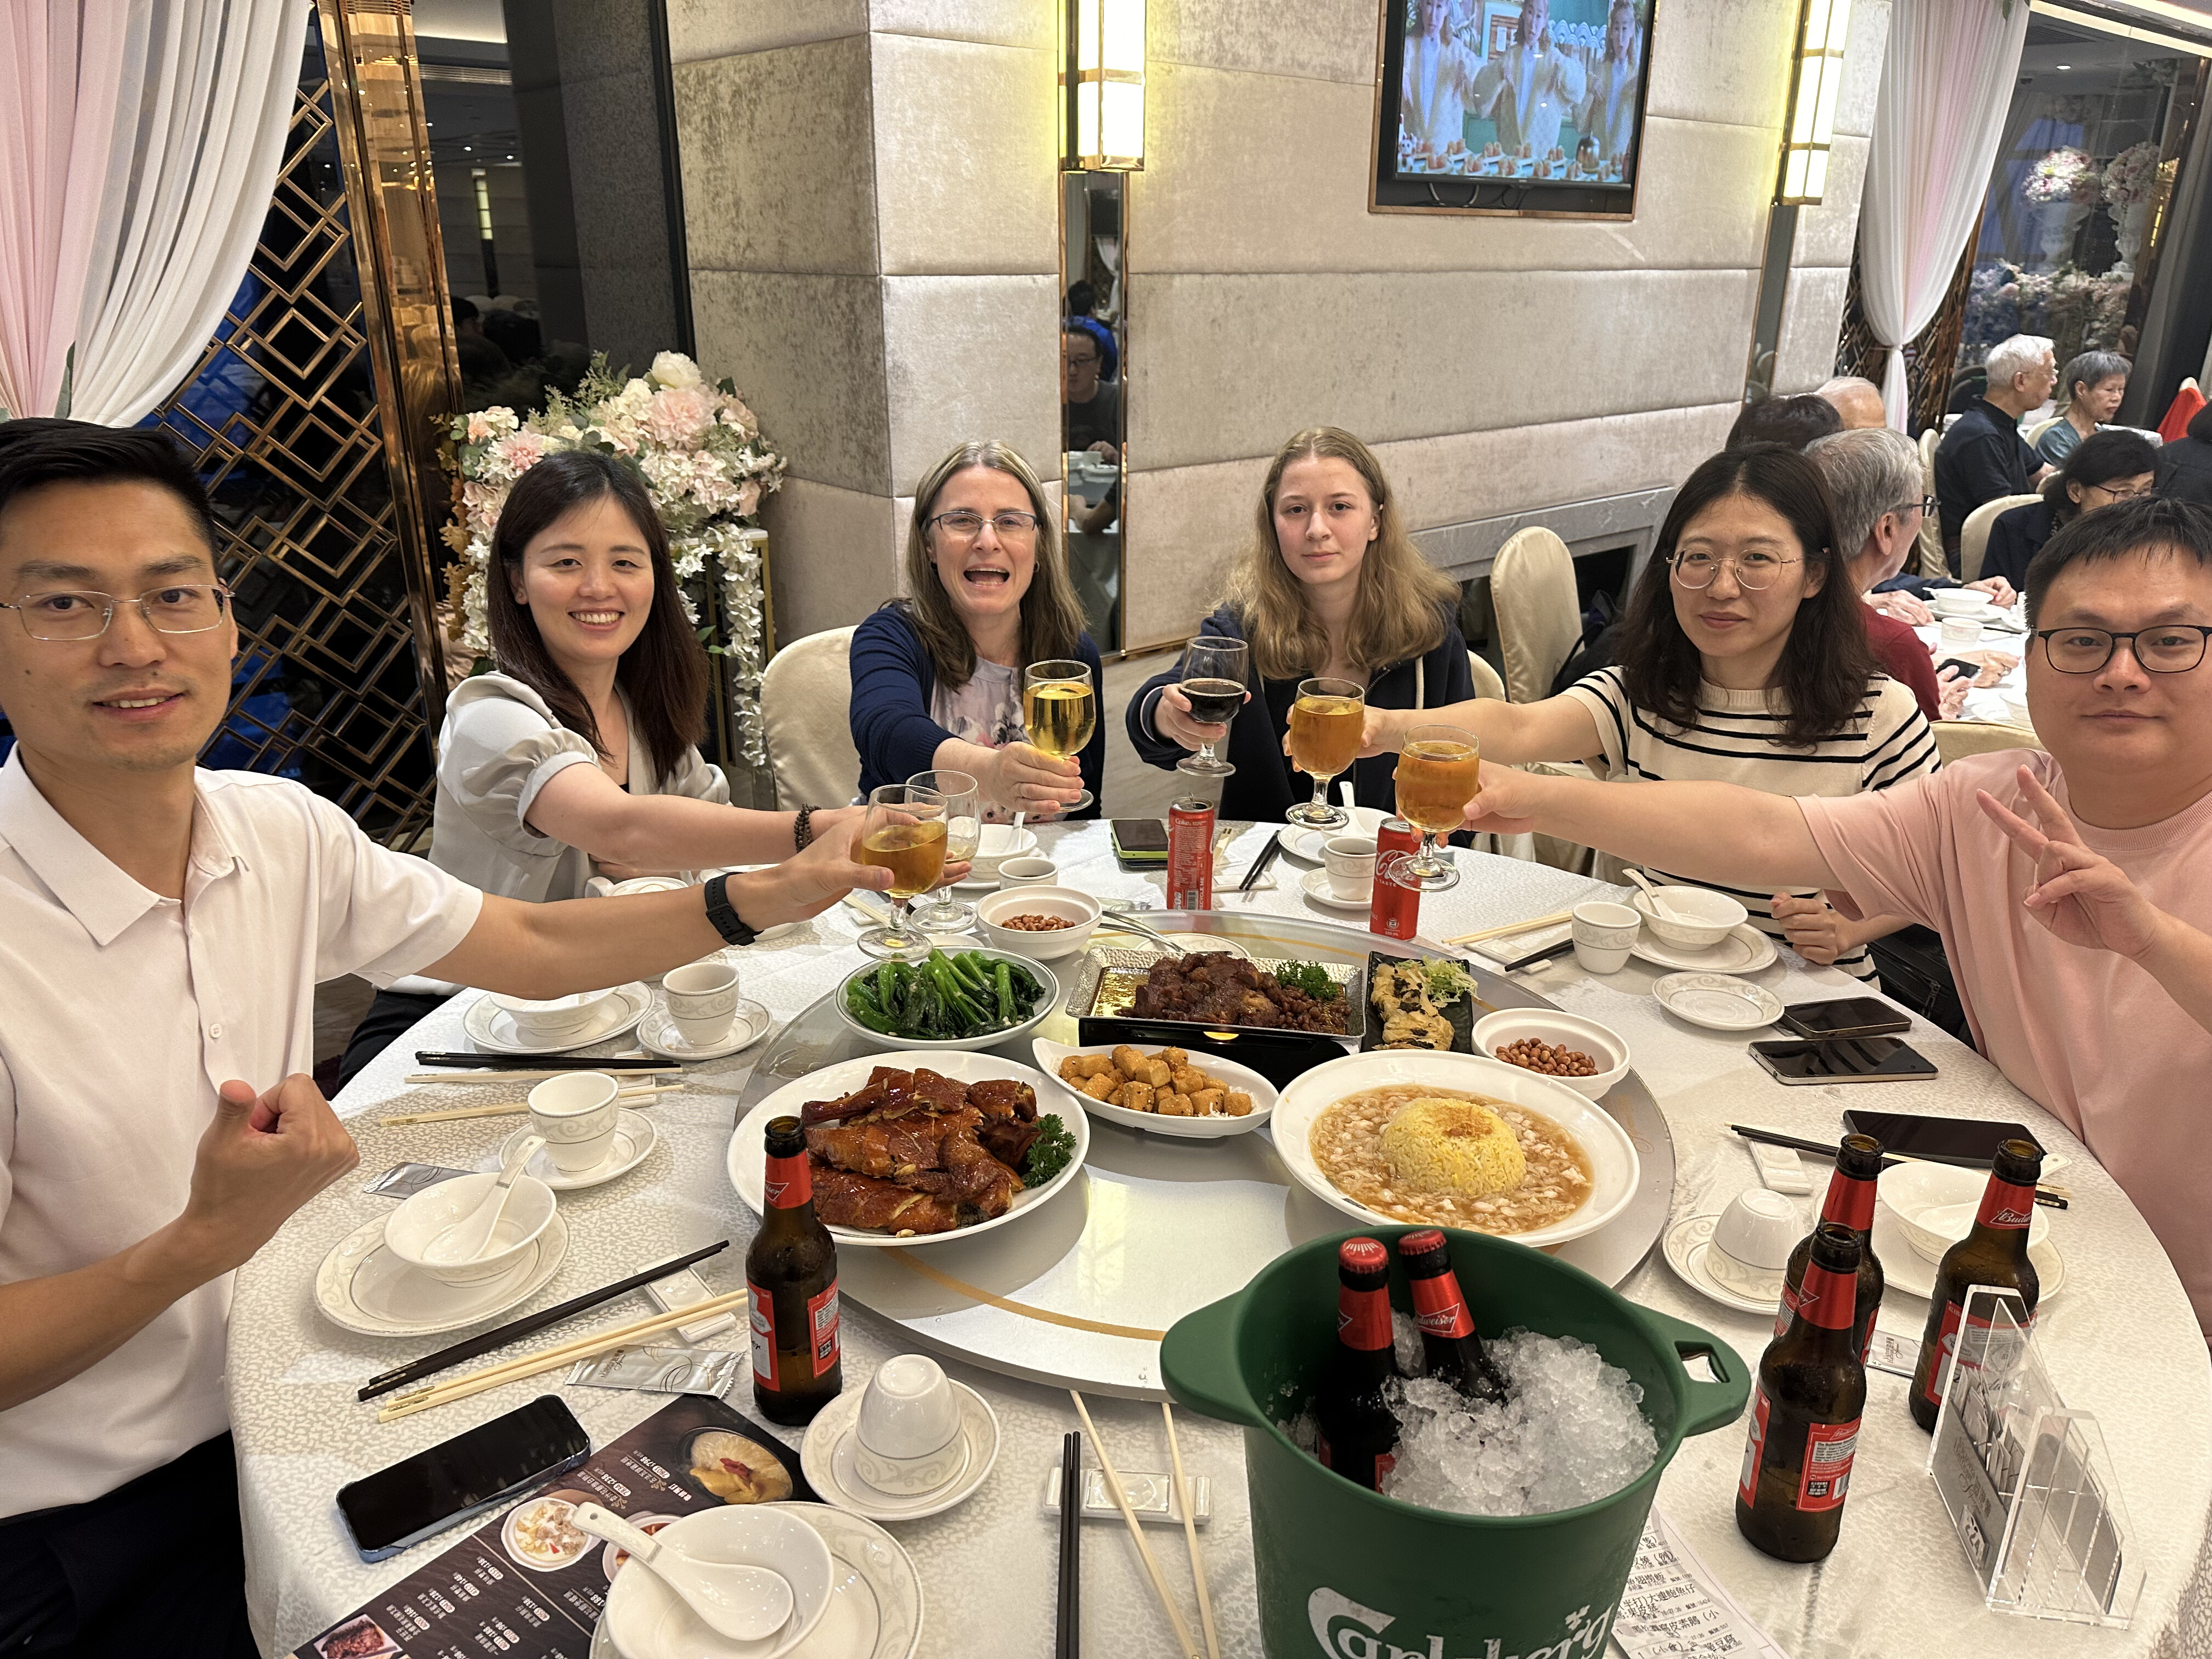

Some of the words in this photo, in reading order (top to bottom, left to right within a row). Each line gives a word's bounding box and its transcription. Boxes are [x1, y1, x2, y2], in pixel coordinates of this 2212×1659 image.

[1418, 1314, 1456, 1325] dweiser
[640, 1455, 656, 1468] $798
[601, 1472, 617, 1484] $238
